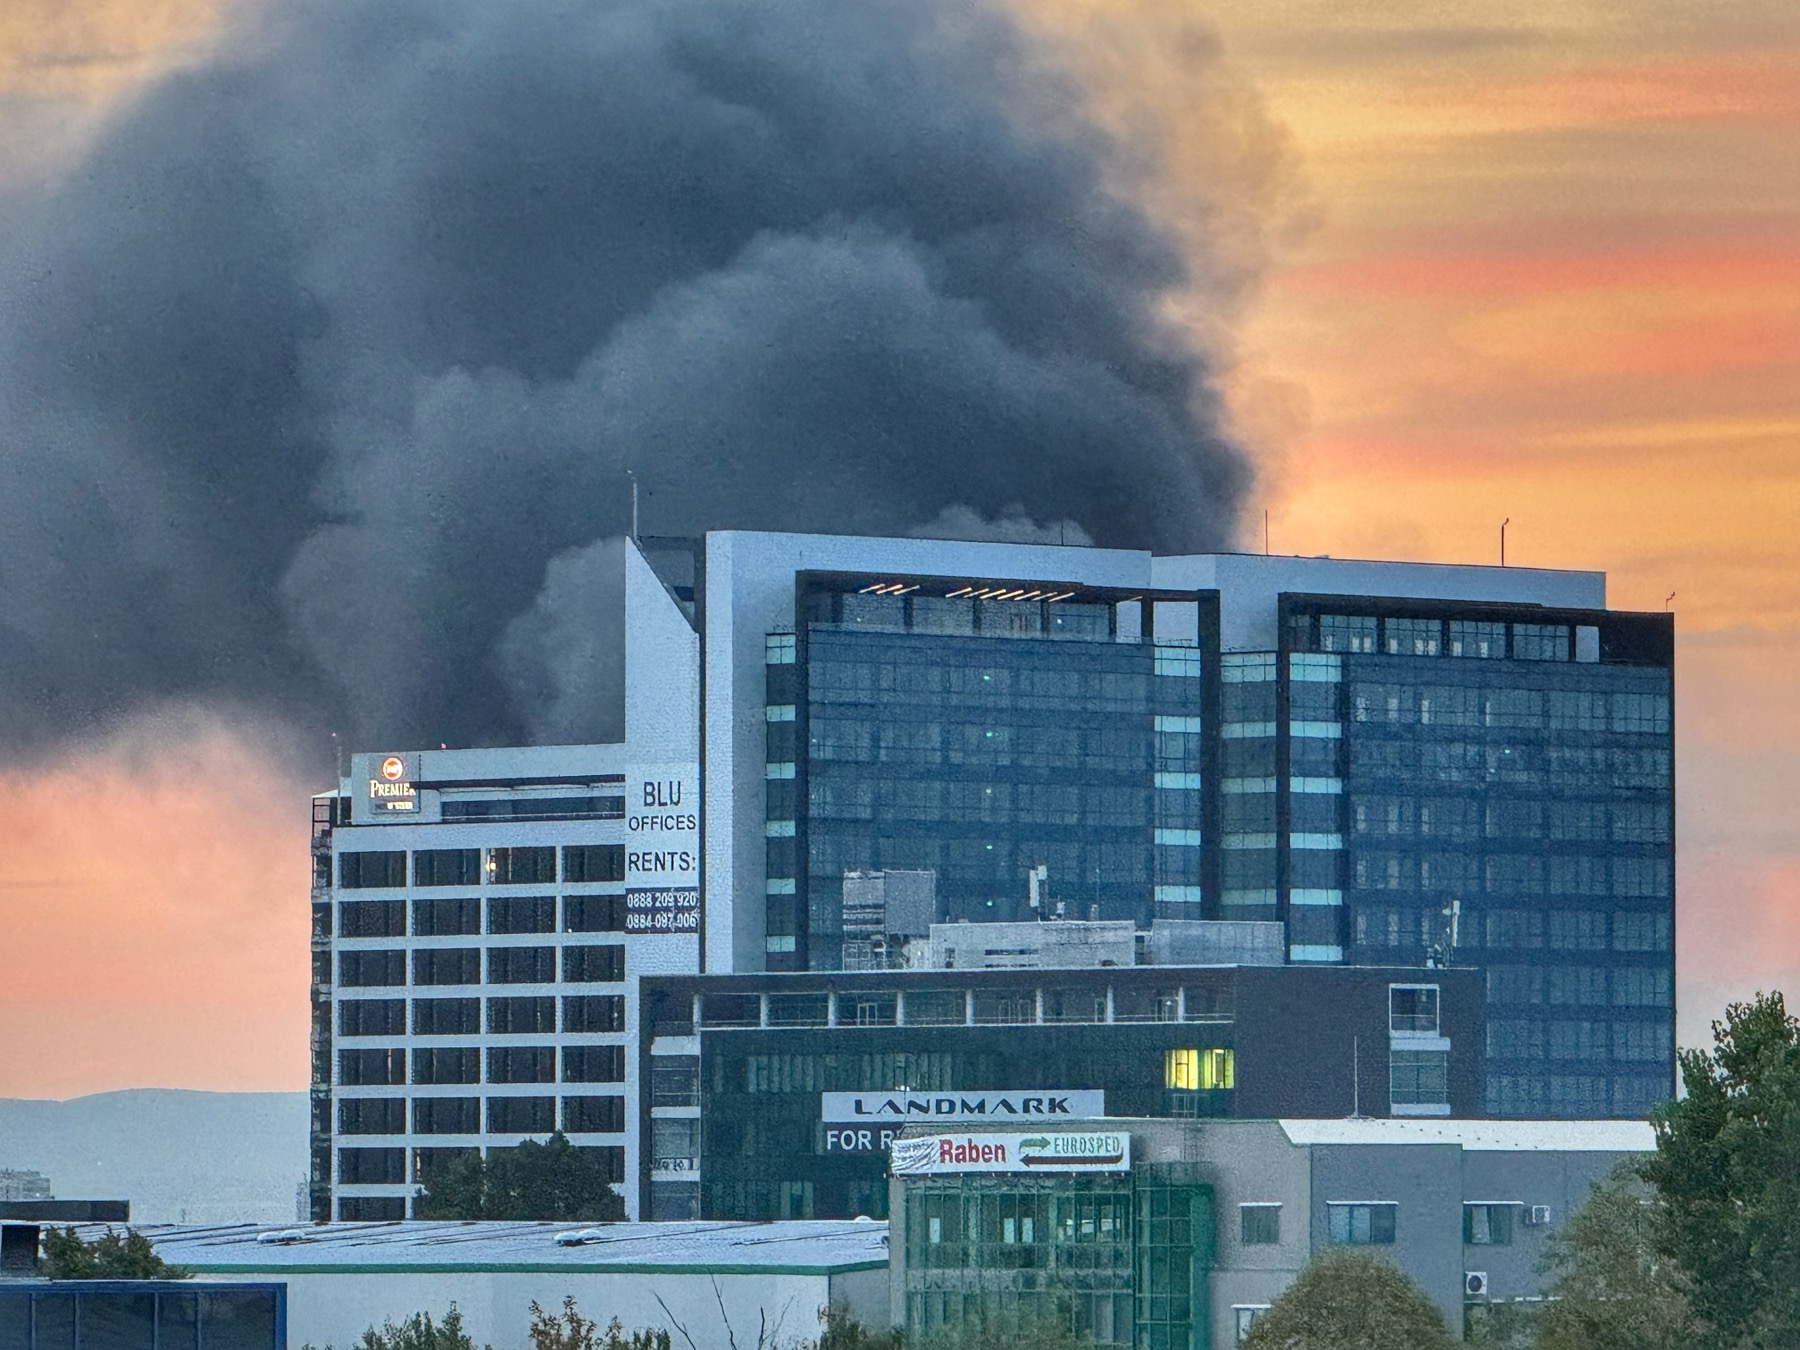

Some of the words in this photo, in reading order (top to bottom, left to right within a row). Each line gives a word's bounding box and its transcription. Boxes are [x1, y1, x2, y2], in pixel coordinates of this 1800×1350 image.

[643, 781, 681, 806] BLU
[628, 814, 696, 831] OFFICES
[628, 852, 696, 871] RENTS:
[855, 1098, 1070, 1114] LANDMARK
[827, 1130, 872, 1150] FOR
[1054, 1136, 1120, 1154] EUROSPED
[939, 1138, 1007, 1164] Raben
